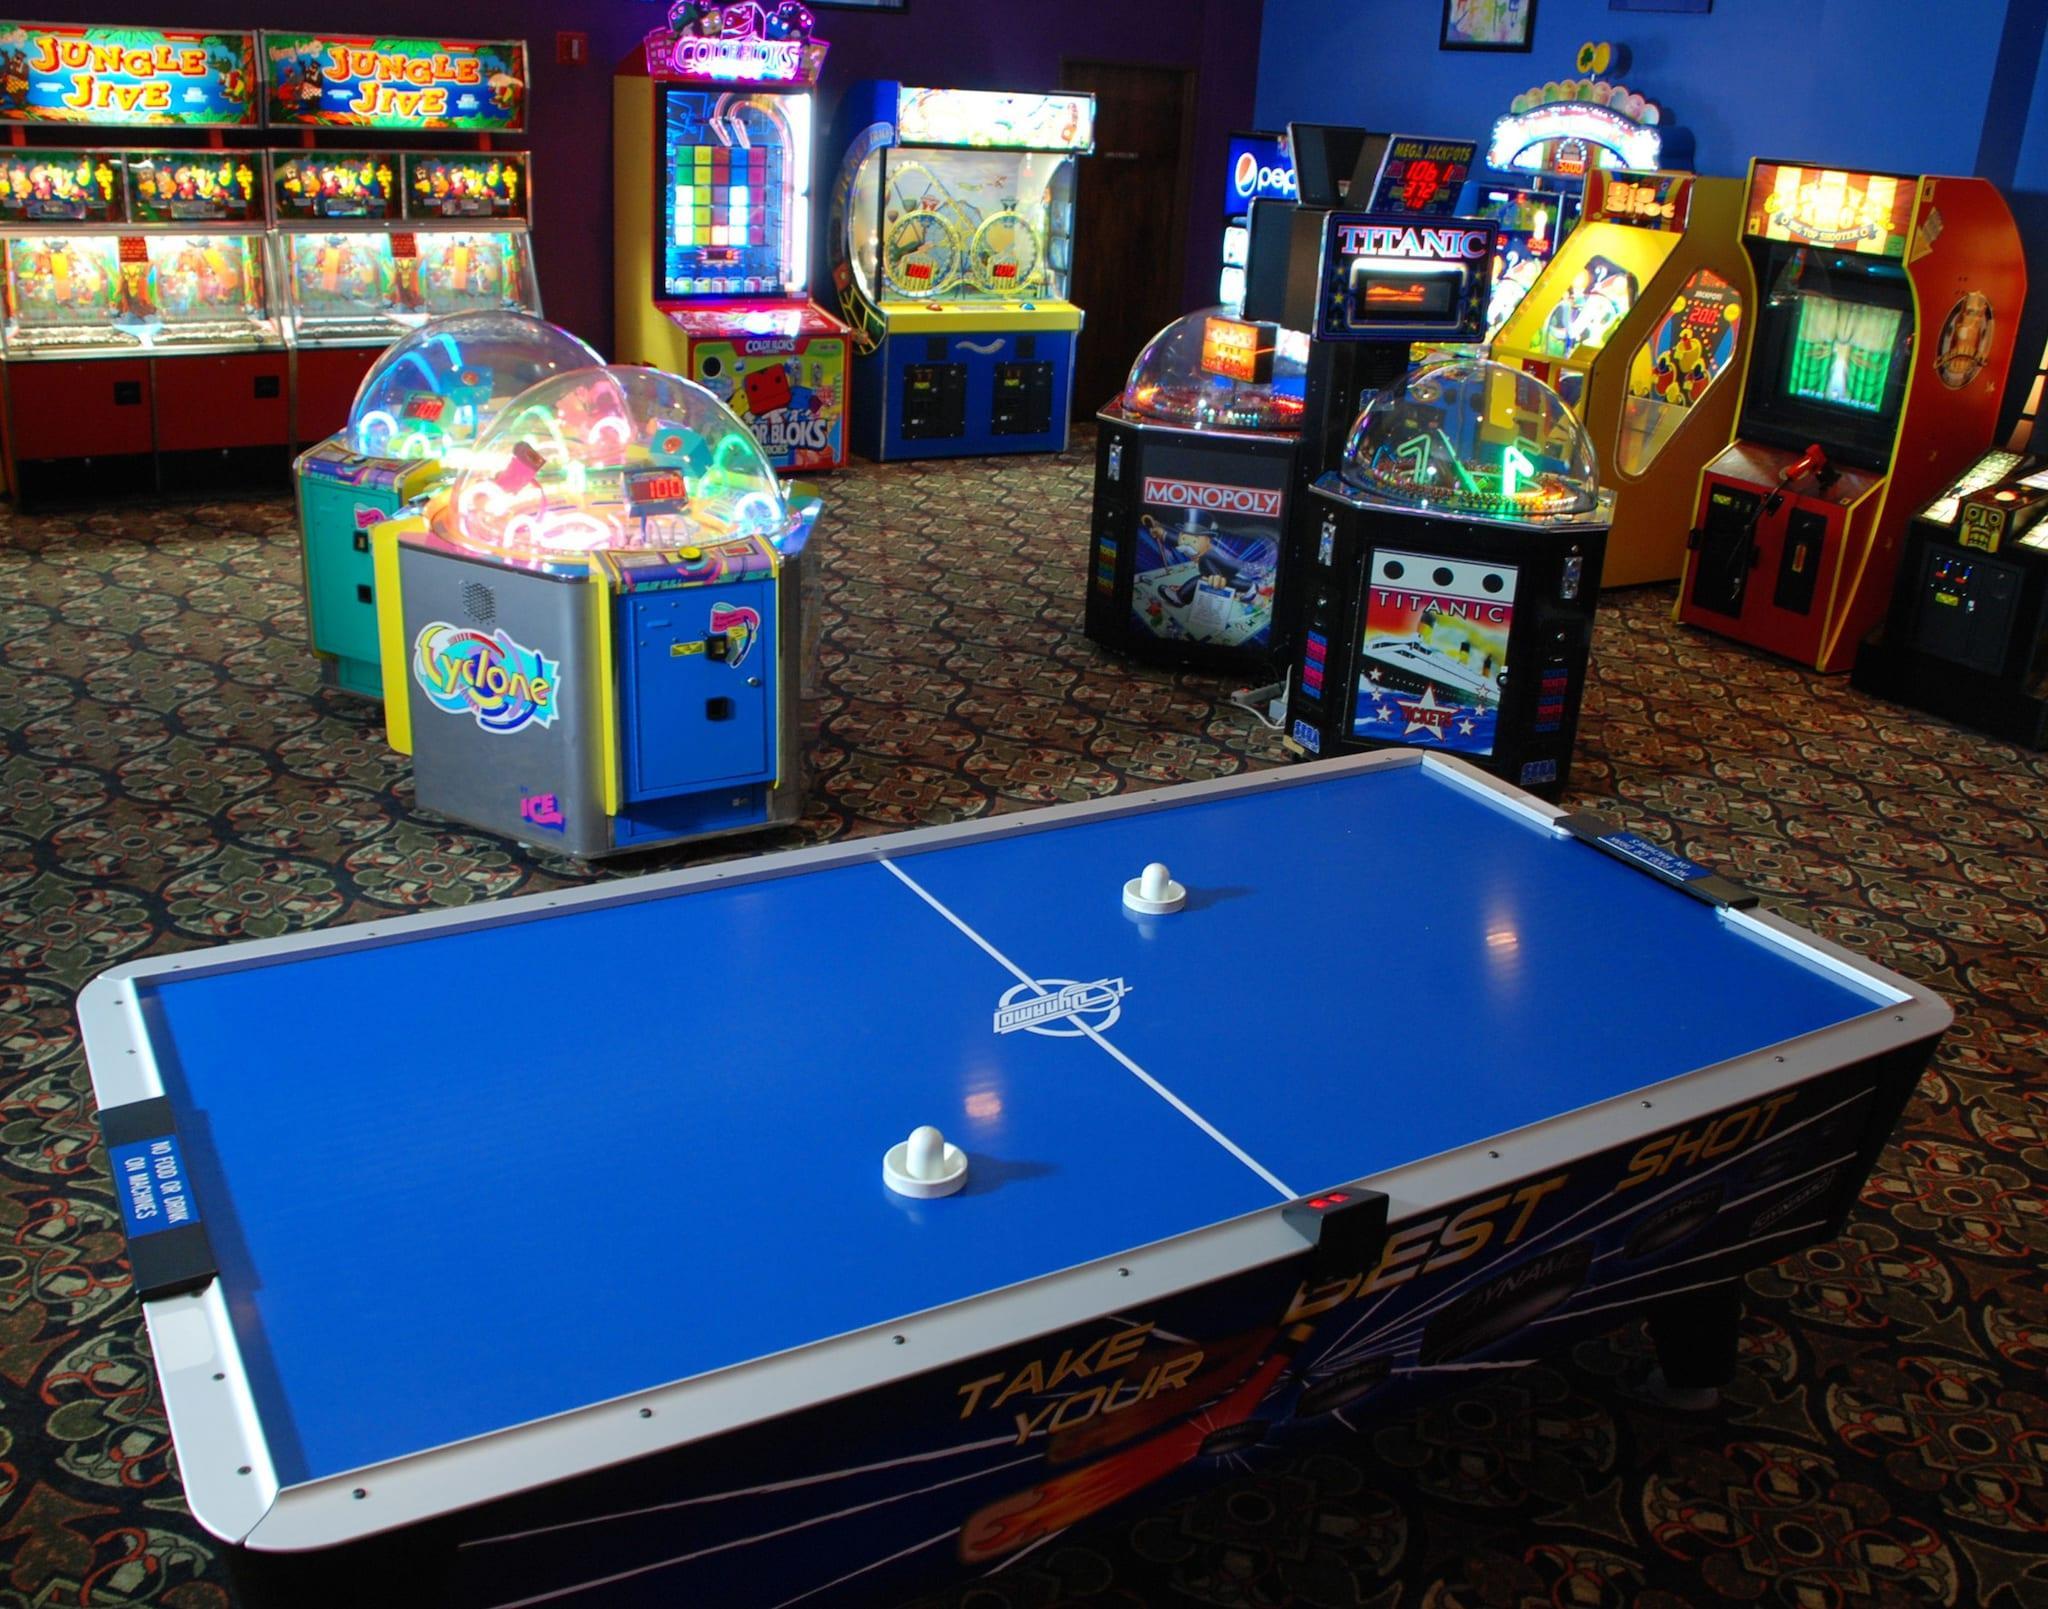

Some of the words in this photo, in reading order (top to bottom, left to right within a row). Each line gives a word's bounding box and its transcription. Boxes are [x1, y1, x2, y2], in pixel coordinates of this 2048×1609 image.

[31, 36, 206, 77] JUNGLE
[323, 46, 480, 85] JUNGLE
[64, 74, 170, 112] JIVE
[351, 81, 448, 116] JIVE
[1395, 143, 1422, 159] MEGA
[1425, 144, 1472, 161] JACKPOTS
[1258, 166, 1296, 195] pep
[1338, 225, 1488, 259] TITANIC
[1803, 227, 1819, 239] TOP
[1820, 230, 1859, 242] SHOOTER
[1689, 307, 1719, 324] 200
[772, 418, 827, 449] BLOKS
[650, 477, 684, 499] 100
[1148, 484, 1278, 513] MONOPOLY
[1378, 591, 1504, 623] TITANIC
[419, 625, 552, 706] Cyclone
[150, 1140, 172, 1156] NO
[1615, 1091, 1801, 1193] SHOT
[124, 1156, 146, 1172] ON
[154, 1155, 178, 1180] FOOD
[128, 1173, 158, 1220] MACHINES
[159, 1180, 183, 1195] OR
[163, 1195, 190, 1224] DRINK
[955, 1320, 1156, 1420] TAKE
[1012, 1350, 1205, 1446] YOUR
